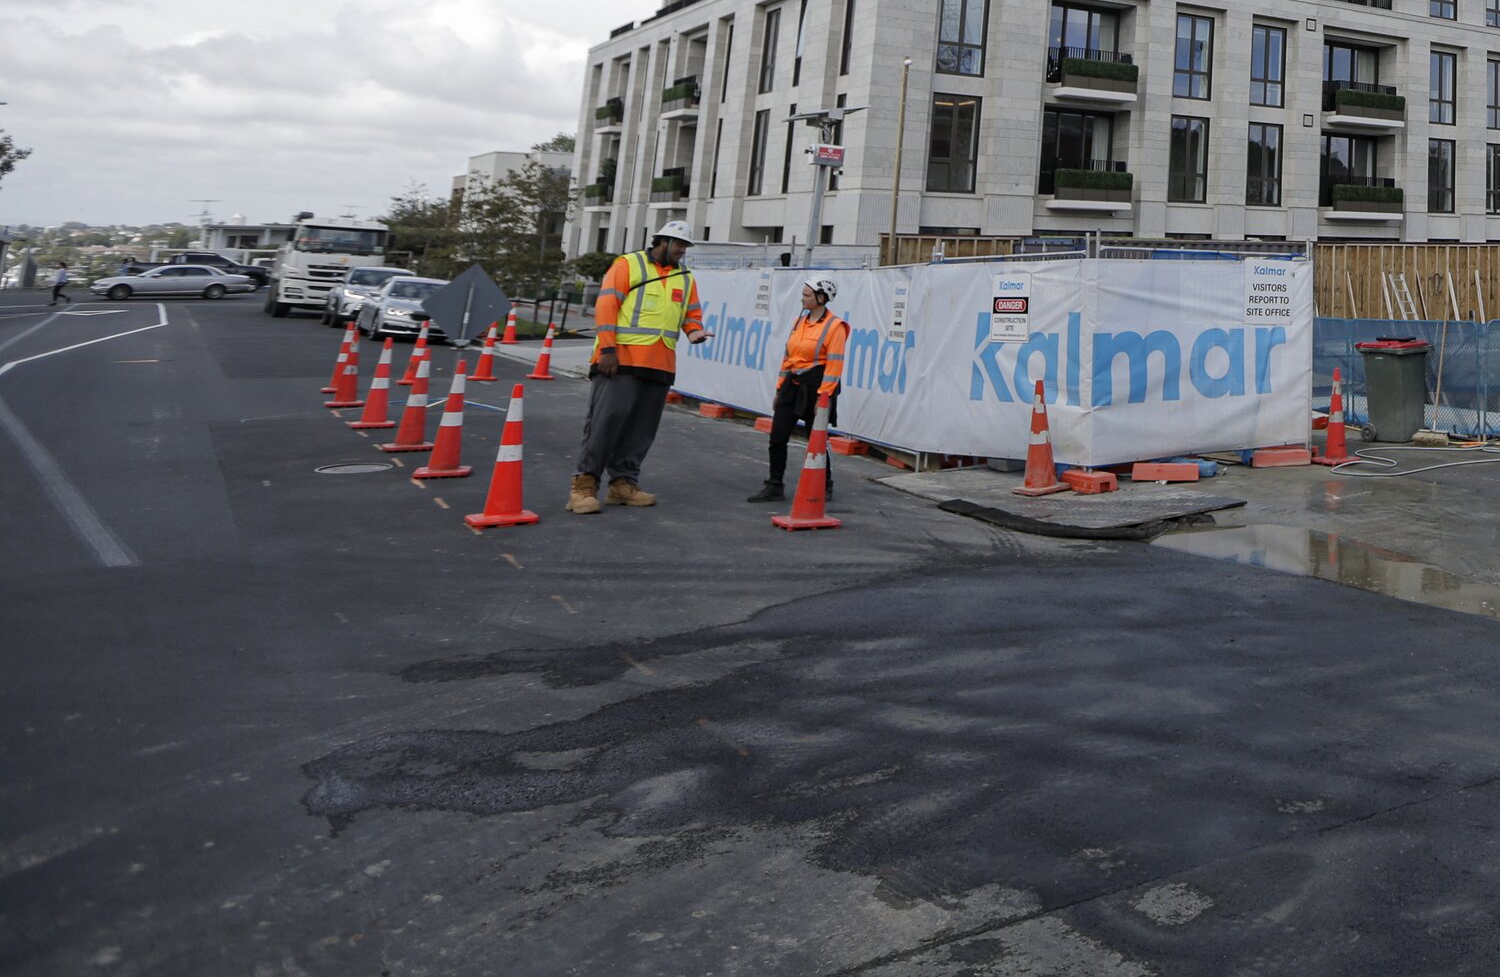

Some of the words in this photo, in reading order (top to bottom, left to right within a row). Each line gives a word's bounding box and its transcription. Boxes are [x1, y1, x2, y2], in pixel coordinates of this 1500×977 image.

[1254, 266, 1286, 276] Kalmar
[999, 281, 1024, 291] Kalmar
[1252, 283, 1287, 292] VISITORS
[1249, 295, 1278, 304] REPORT
[1280, 296, 1290, 305] TO
[998, 301, 1023, 310] DANGER
[1246, 308, 1263, 317] SITE
[1265, 308, 1291, 317] OFFICE
[970, 312, 1286, 407] Kalmar
